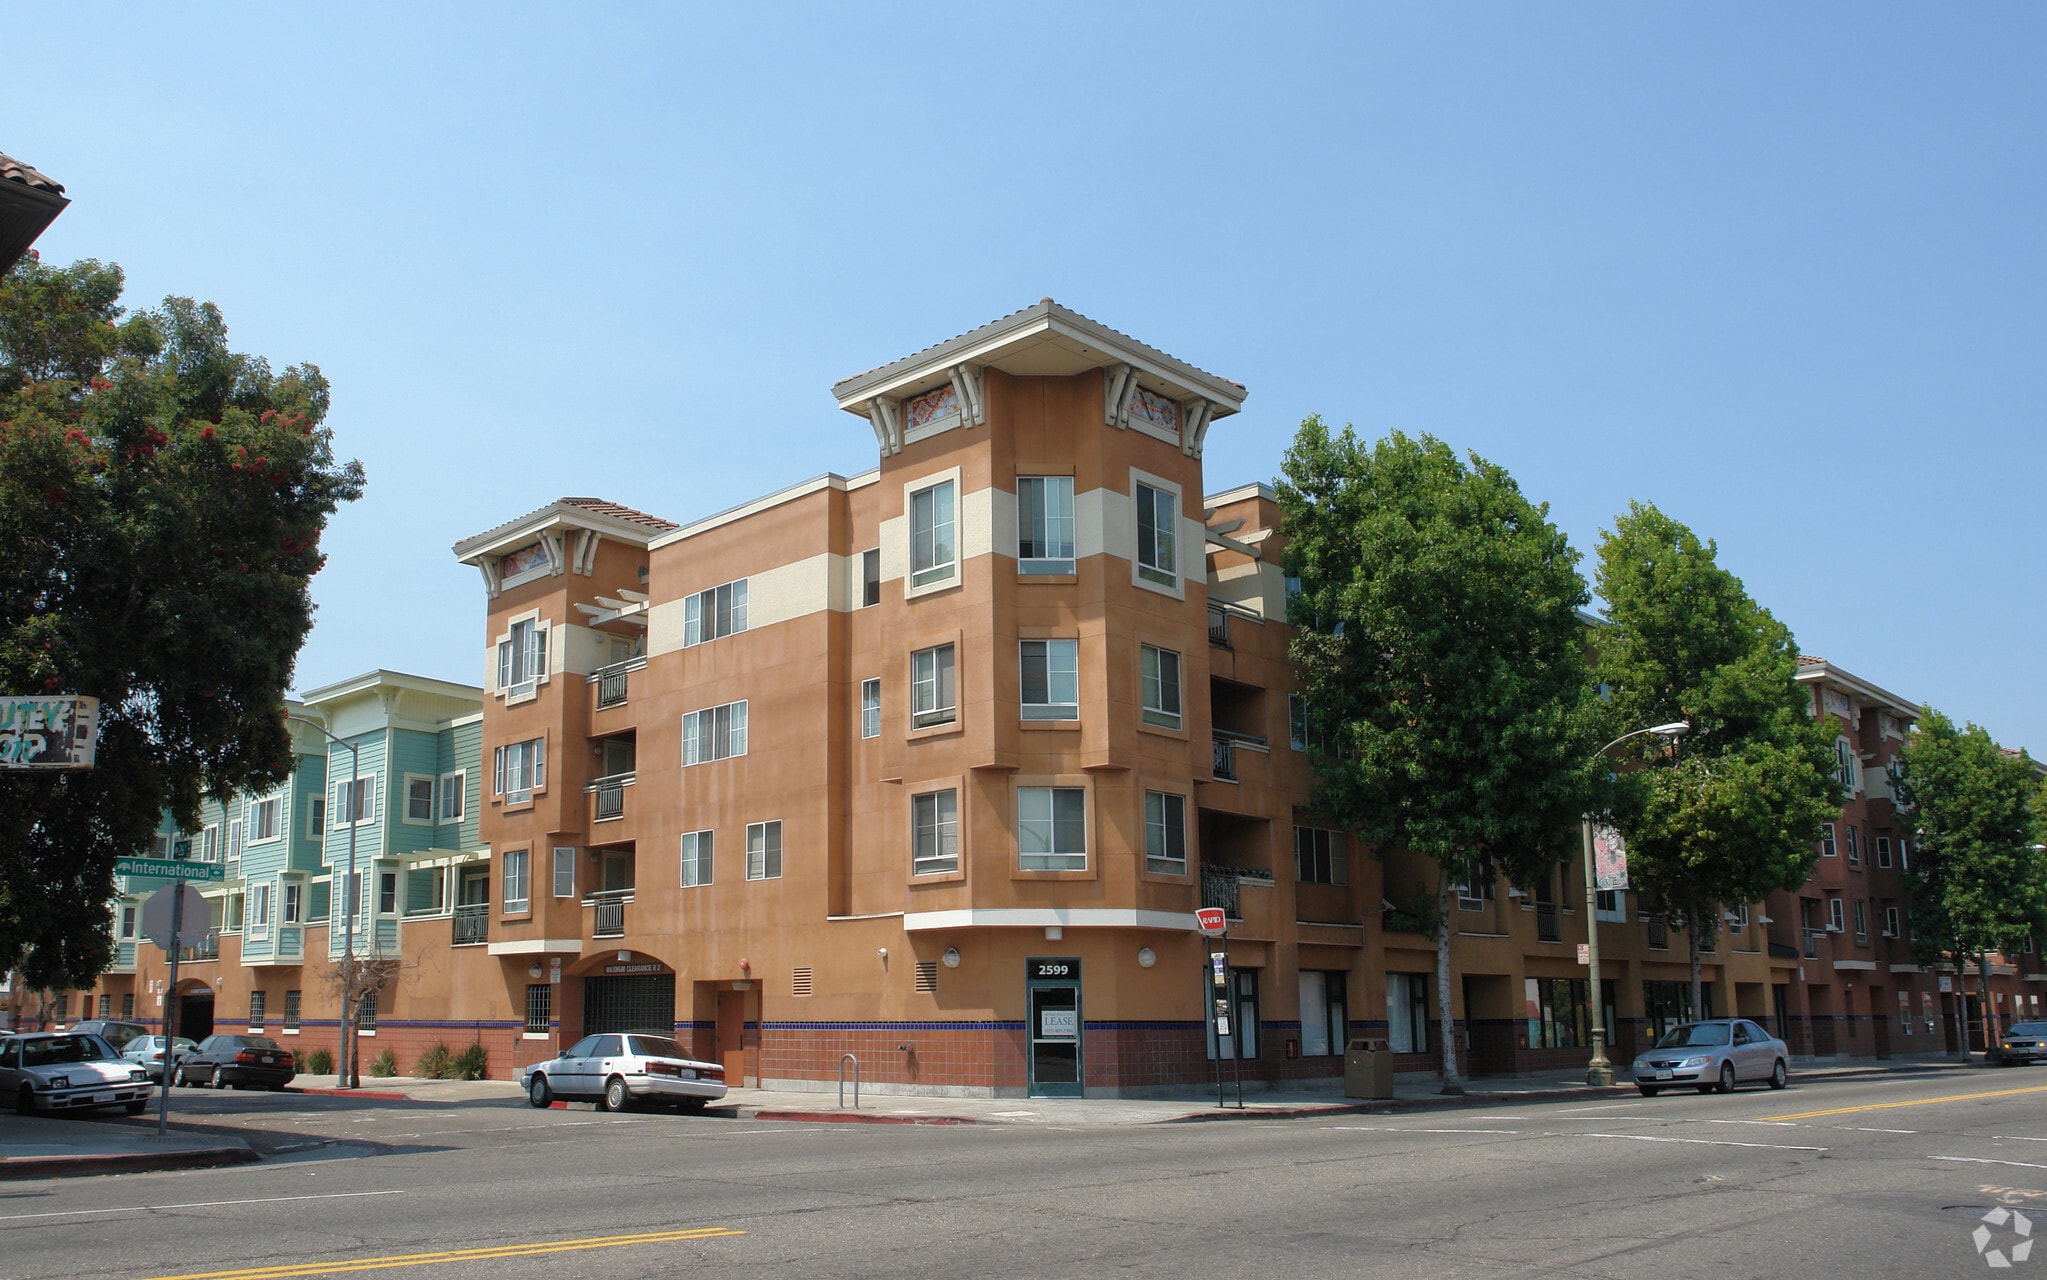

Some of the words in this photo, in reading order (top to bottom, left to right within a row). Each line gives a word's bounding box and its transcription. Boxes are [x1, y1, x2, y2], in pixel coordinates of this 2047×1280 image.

[131, 861, 209, 878] International
[1202, 916, 1221, 924] RAPID
[626, 964, 652, 973] CLEARANCE
[1038, 965, 1069, 975] 2599
[1044, 1016, 1074, 1026] LEASE
